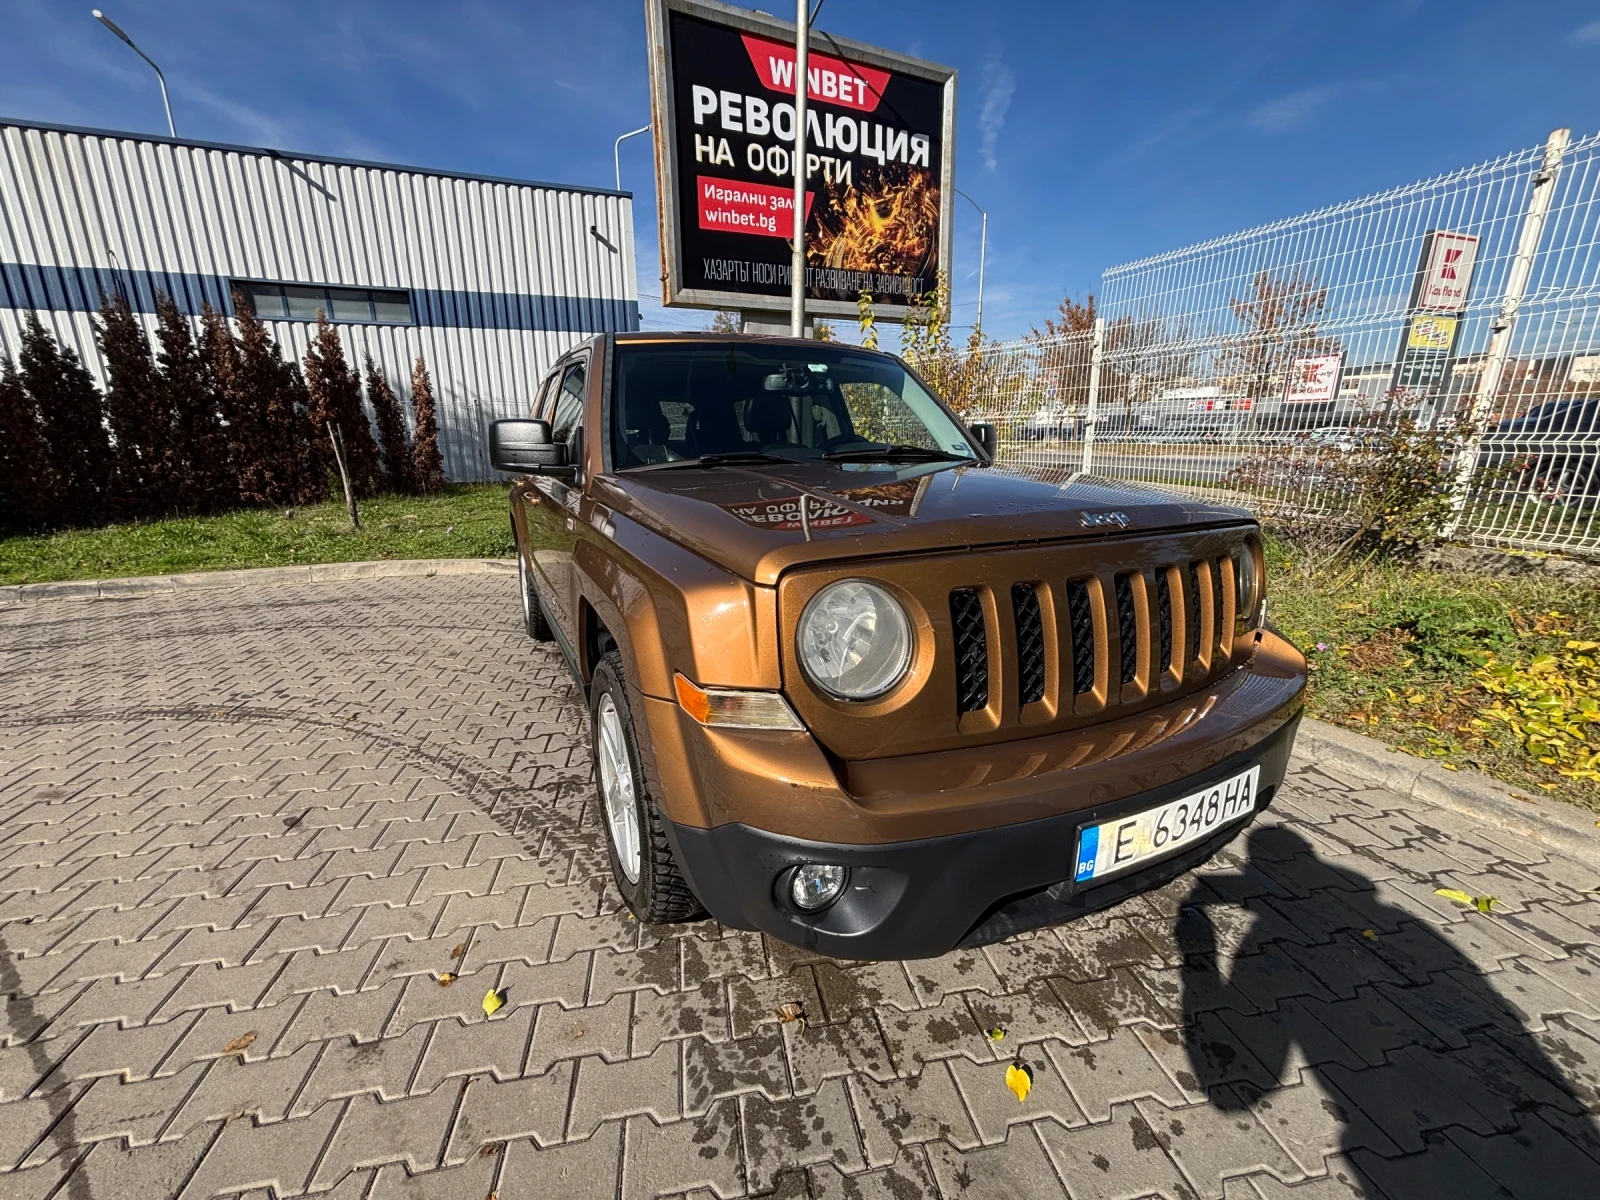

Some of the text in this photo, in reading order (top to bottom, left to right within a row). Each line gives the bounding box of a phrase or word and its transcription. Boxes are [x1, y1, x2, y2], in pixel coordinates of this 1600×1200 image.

[769, 56, 868, 105] WNBET
[694, 133, 735, 168] НА
[704, 183, 796, 211] Игрални зал
[705, 207, 776, 232] winbet.bg
[703, 258, 750, 282] ХАЗАРТЪТ
[752, 262, 777, 285] НОСИ
[863, 273, 873, 292] НА
[1079, 511, 1130, 529] Jeep
[1114, 820, 1137, 865] E
[1078, 859, 1094, 875] BG
